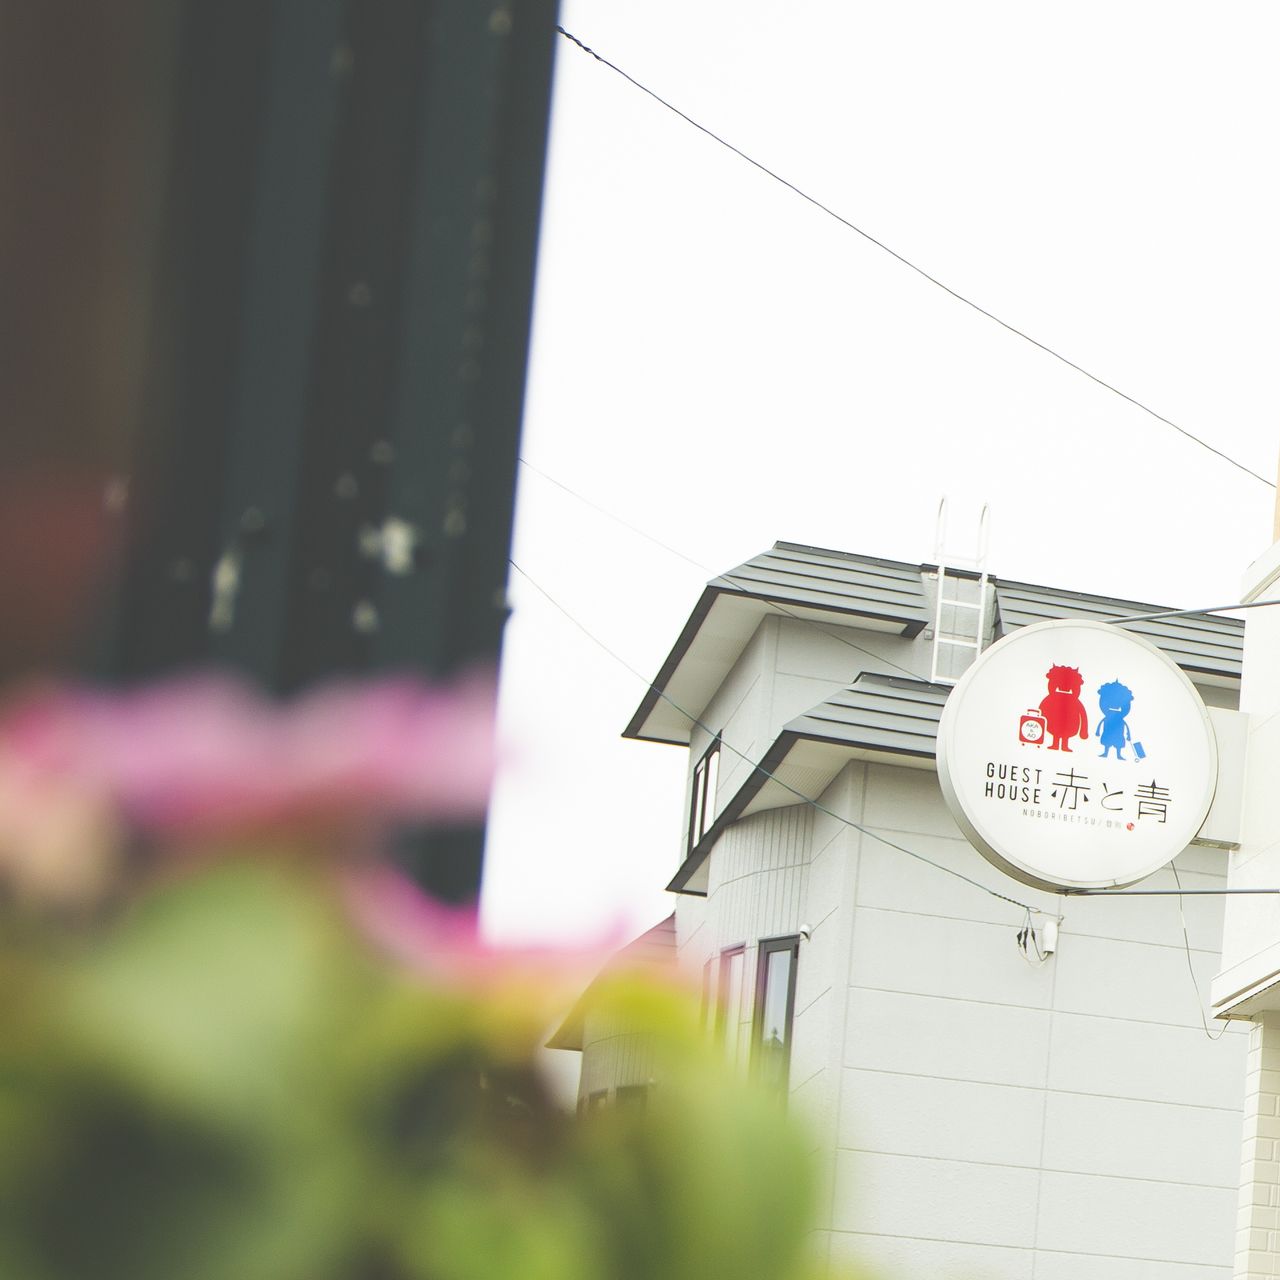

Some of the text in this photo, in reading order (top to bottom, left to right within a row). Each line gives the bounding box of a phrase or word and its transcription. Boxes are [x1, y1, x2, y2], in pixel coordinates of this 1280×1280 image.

[986, 762, 1042, 785] GUEST
[985, 782, 1041, 804] HOUSE
[1050, 767, 1172, 824] 赤と青
